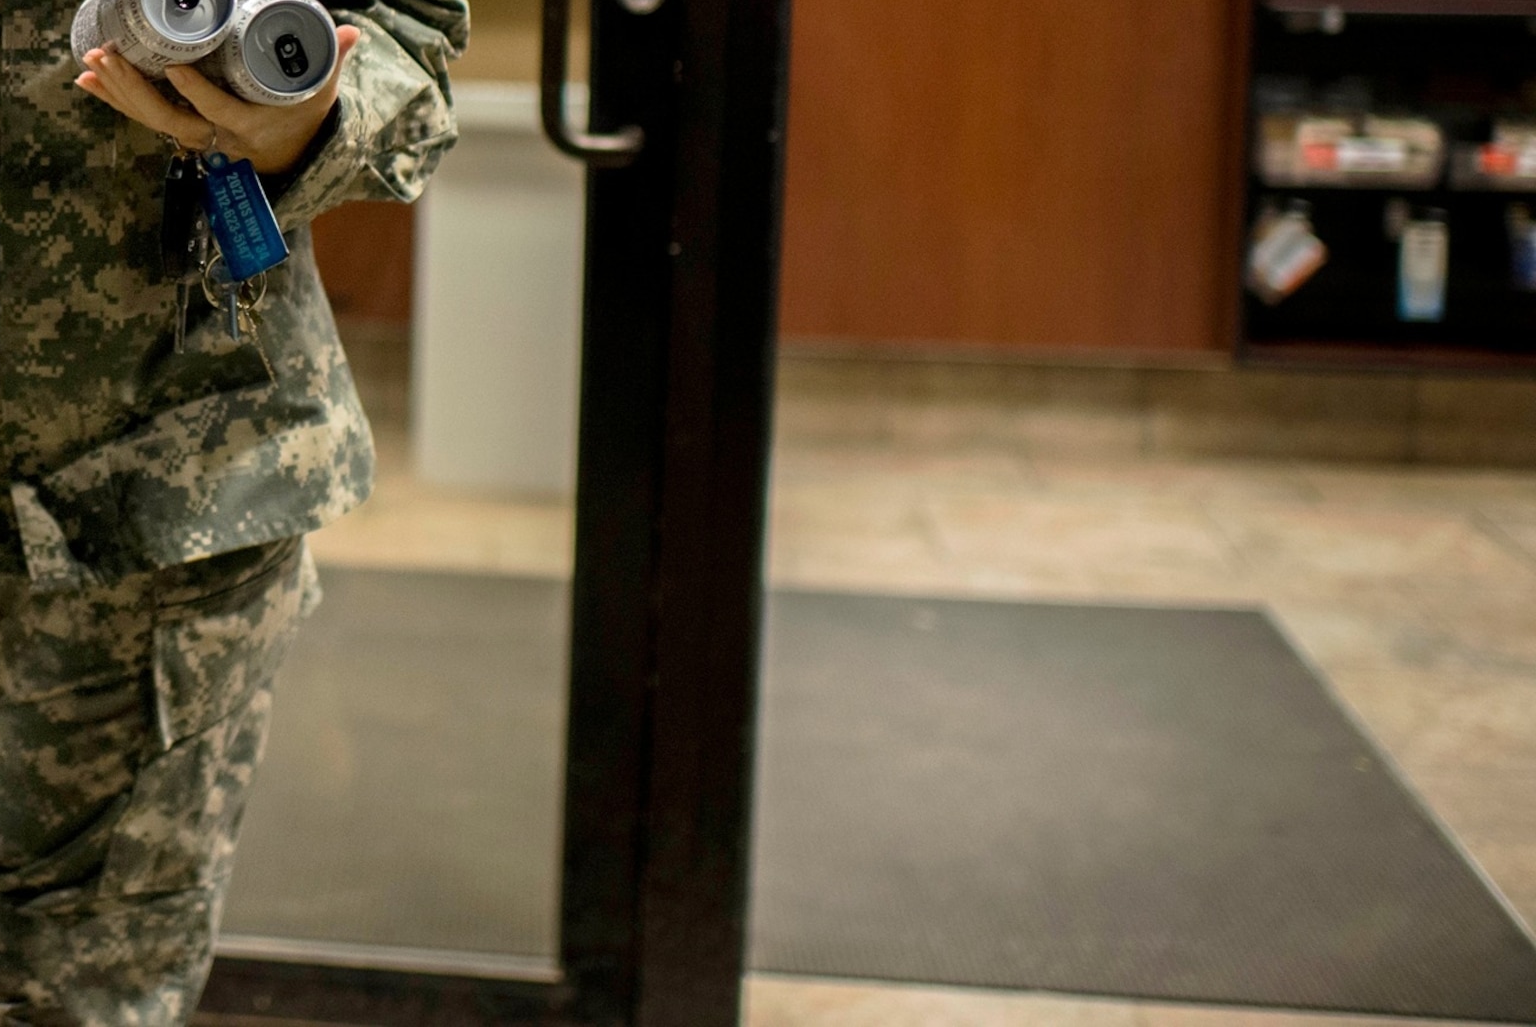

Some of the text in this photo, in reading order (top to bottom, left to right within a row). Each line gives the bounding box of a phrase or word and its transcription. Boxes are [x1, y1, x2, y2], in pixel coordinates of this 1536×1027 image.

[226, 172, 246, 200] 2027
[237, 199, 253, 218] US
[244, 216, 265, 244] HWY
